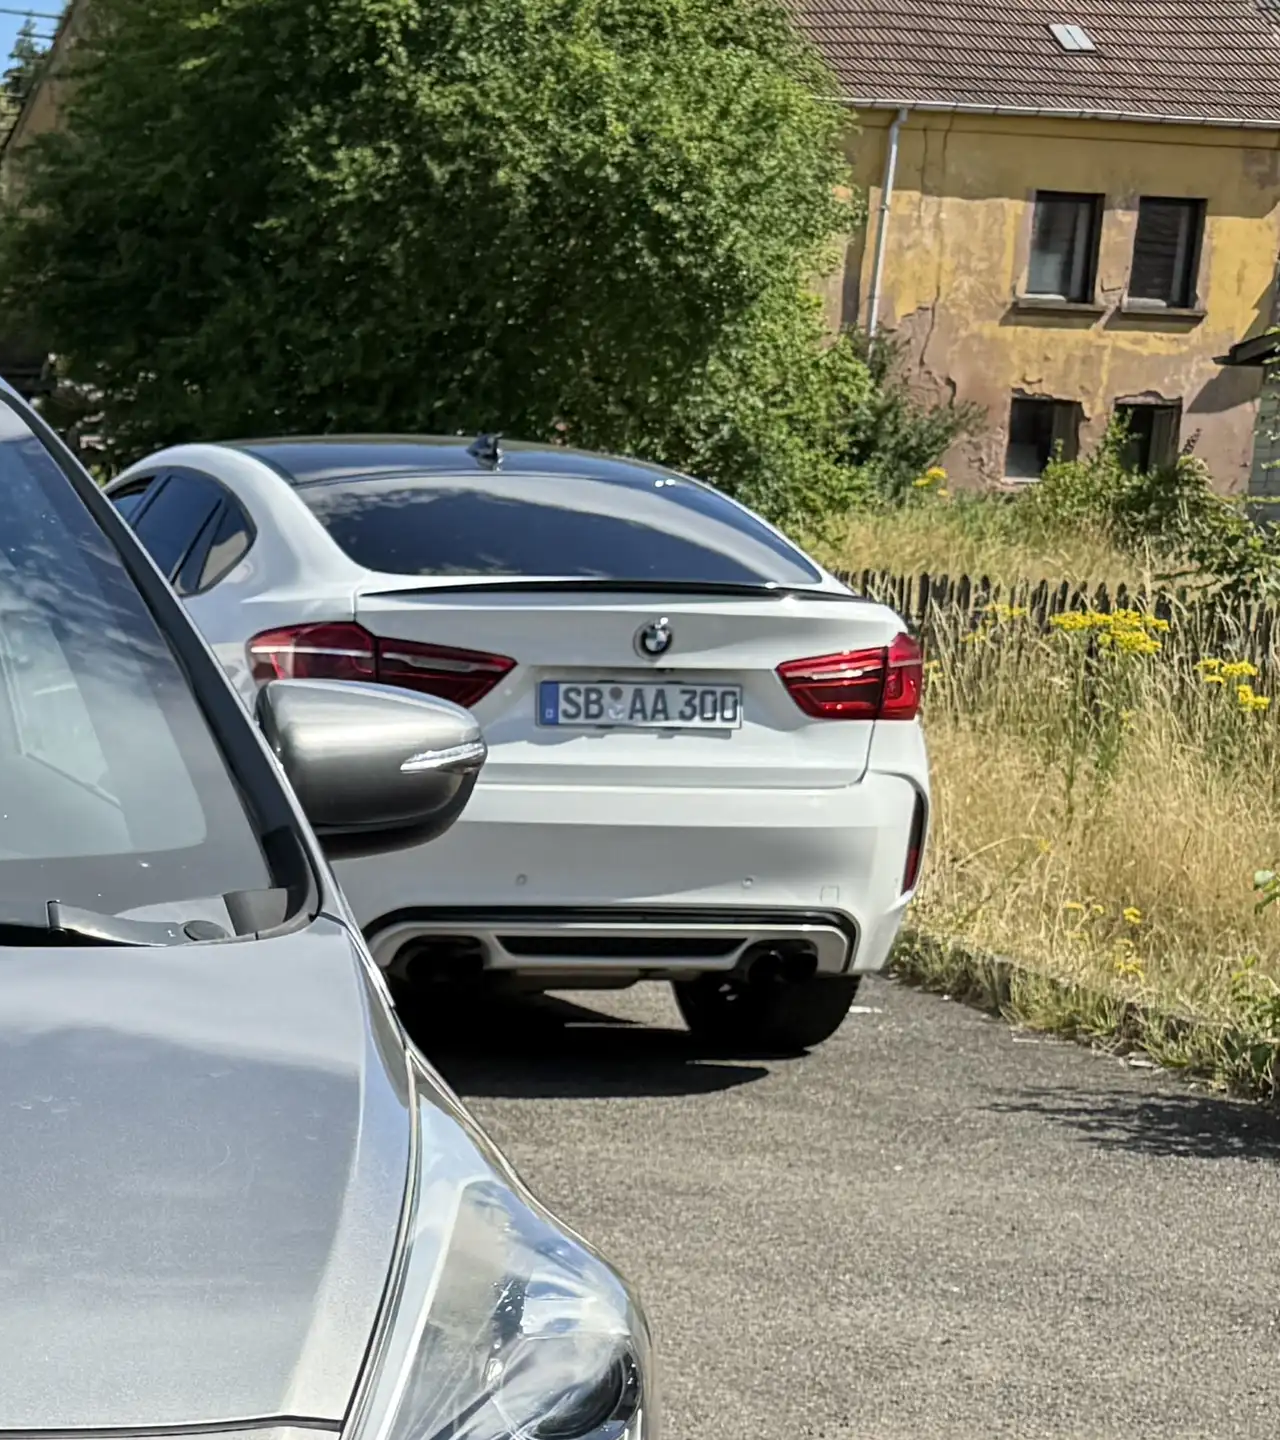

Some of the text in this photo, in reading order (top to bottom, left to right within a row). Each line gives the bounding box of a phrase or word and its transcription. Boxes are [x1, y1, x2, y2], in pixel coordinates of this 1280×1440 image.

[561, 687, 738, 722] SB AA 300
